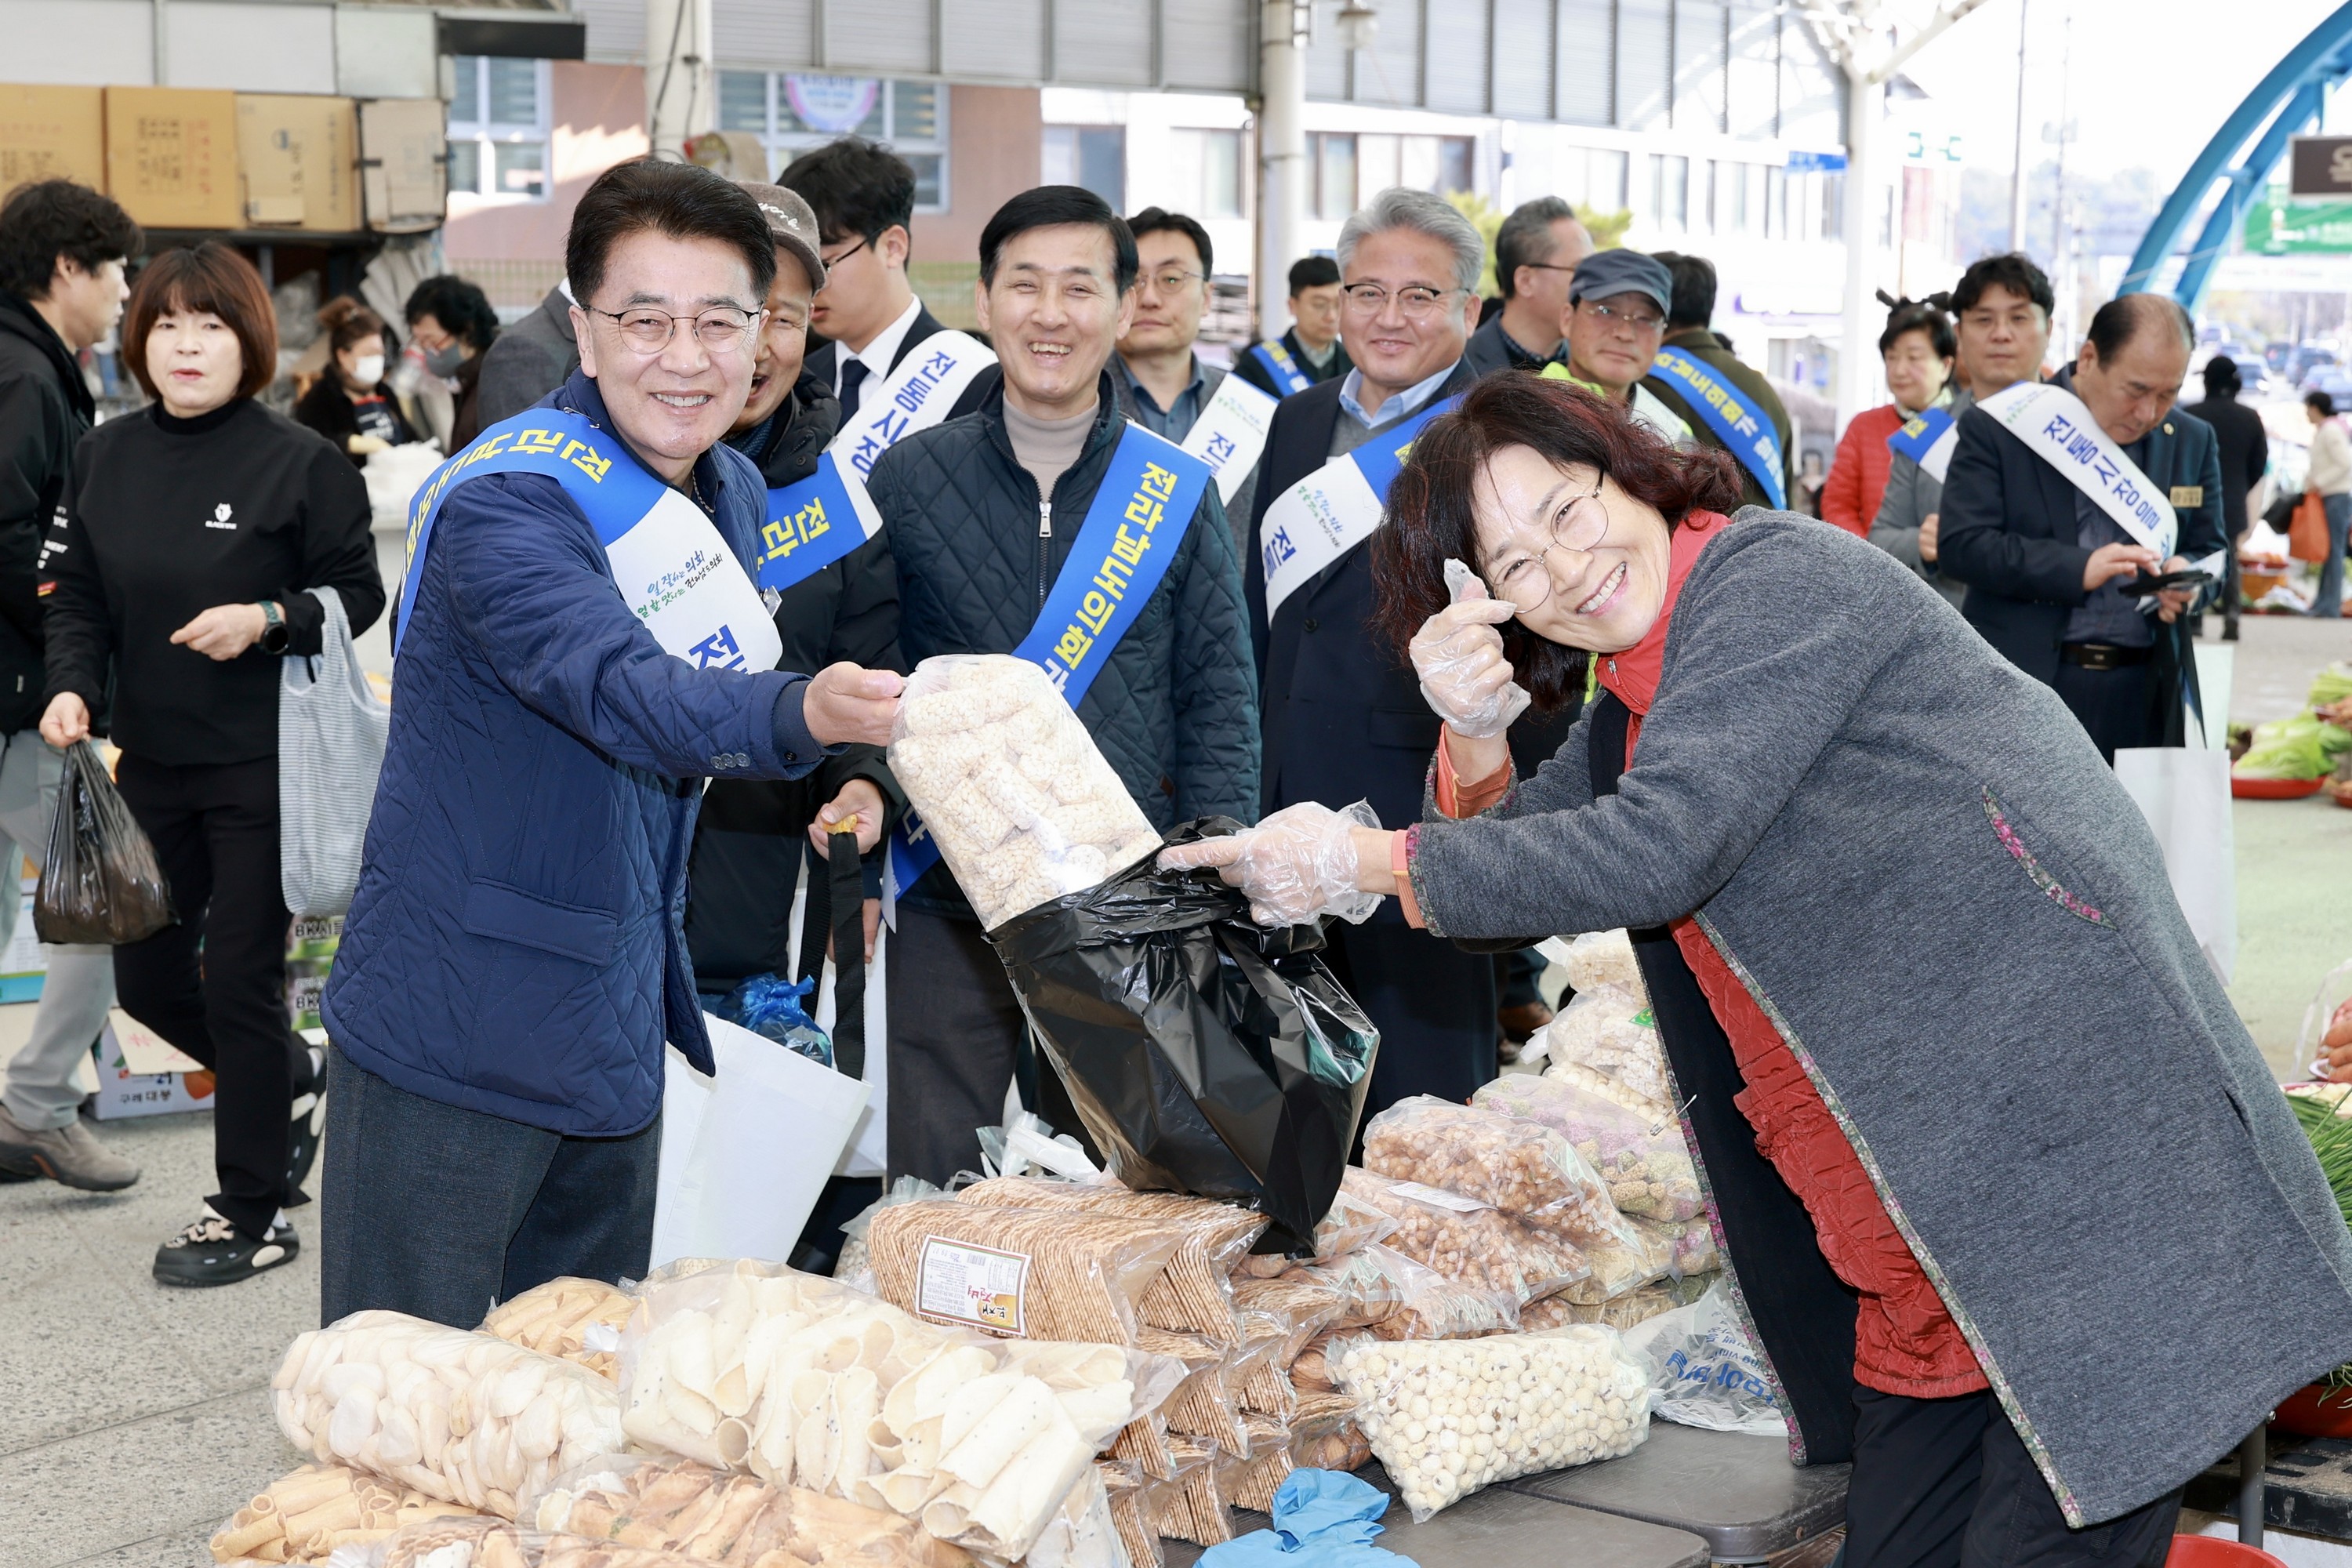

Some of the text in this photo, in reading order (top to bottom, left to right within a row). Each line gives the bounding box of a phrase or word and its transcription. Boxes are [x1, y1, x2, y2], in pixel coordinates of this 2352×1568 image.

[851, 350, 957, 484] 전통시장
[2043, 414, 2161, 532] 전통시장을
[757, 496, 831, 571] 전라
[637, 553, 724, 619] 일 할 맛나는 전라남도의회
[647, 550, 706, 597] 일 잘하는 의회
[967, 1285, 992, 1303] 전병
